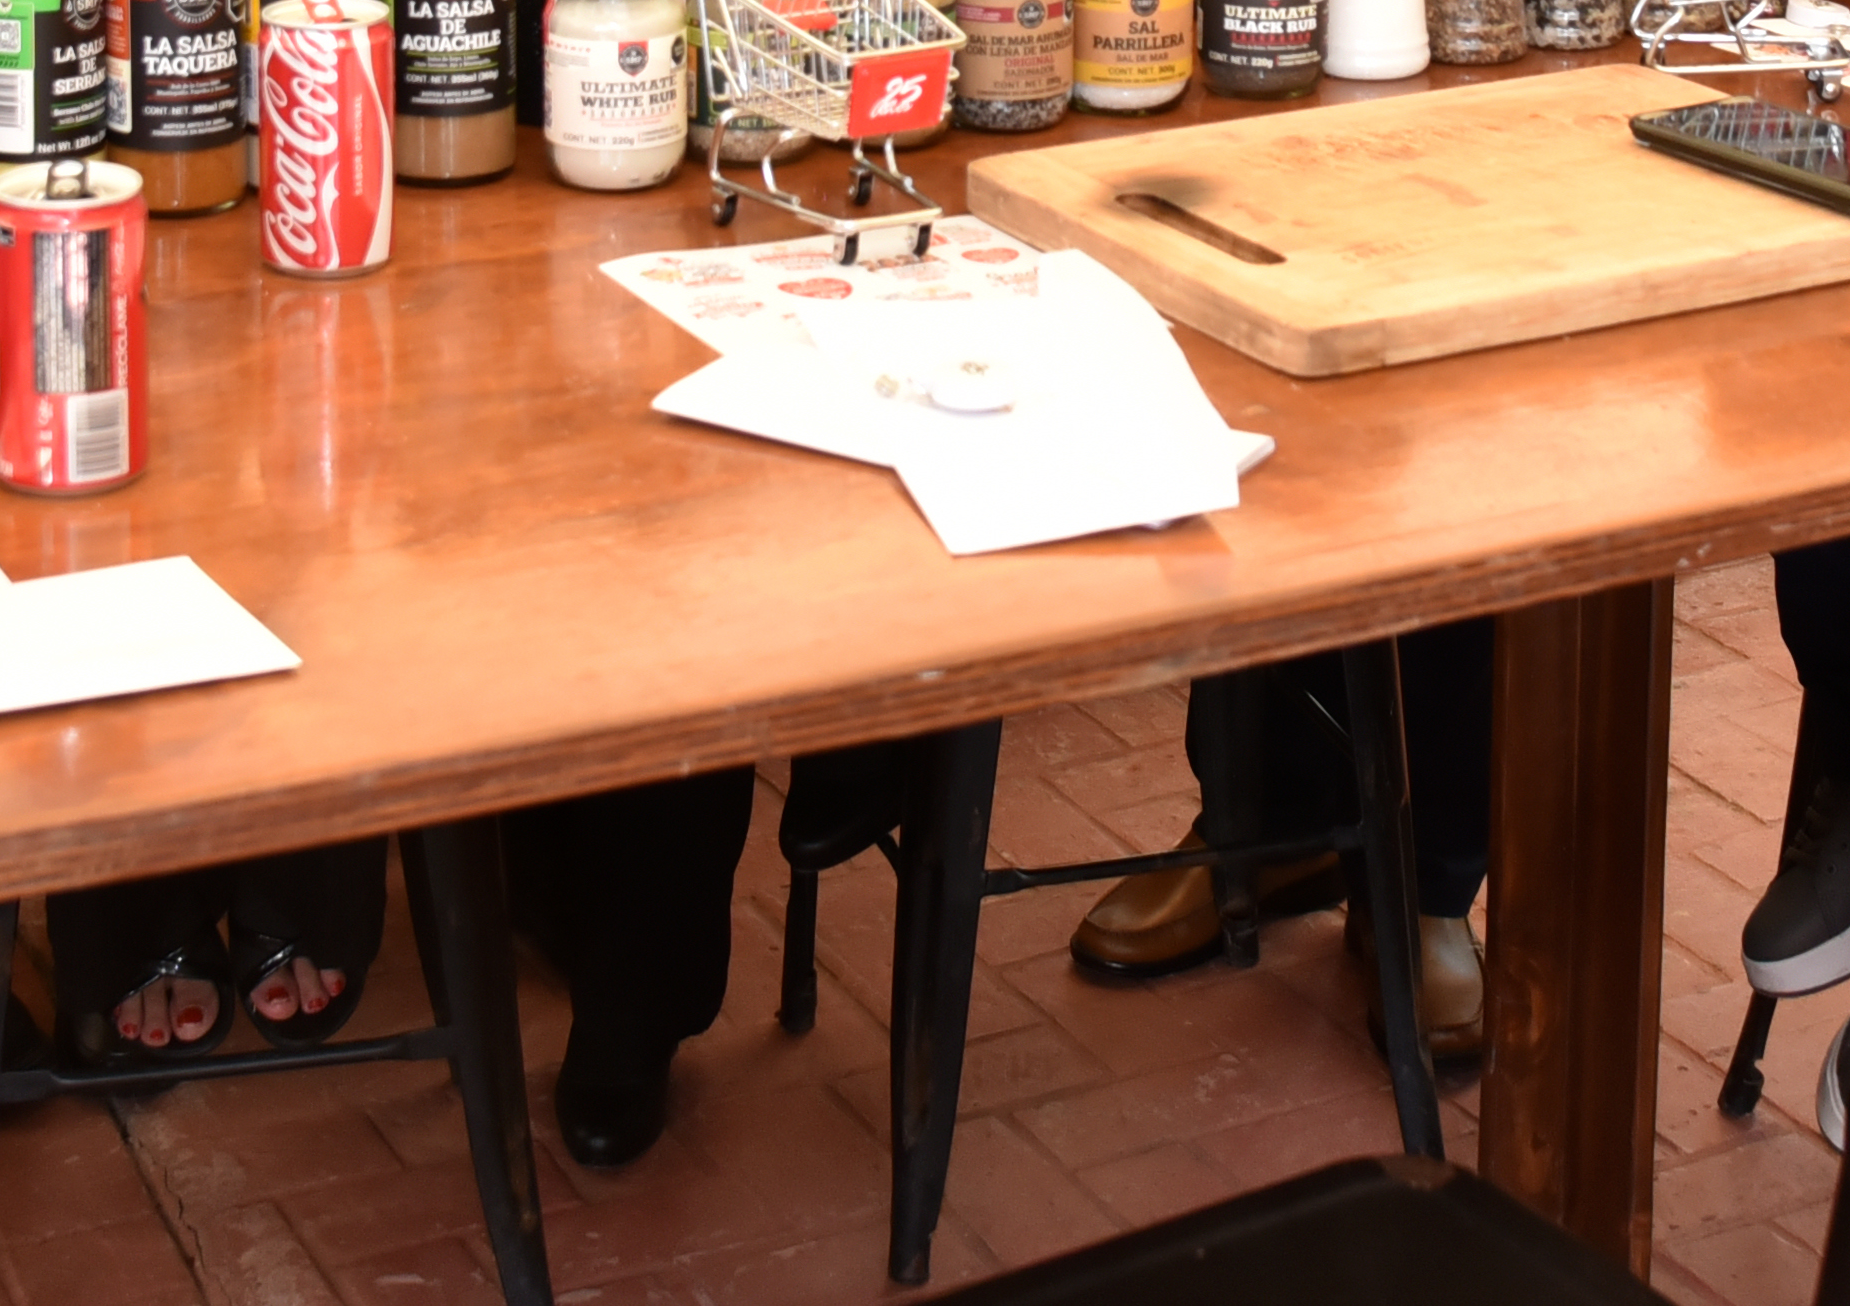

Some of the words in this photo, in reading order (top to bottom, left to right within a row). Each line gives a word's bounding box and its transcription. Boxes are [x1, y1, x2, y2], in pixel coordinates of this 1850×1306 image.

[408, 0, 433, 18] LA
[1224, 4, 1317, 20] ULTIMATE
[440, 19, 467, 35] DE
[1128, 20, 1160, 34] SAL
[1224, 17, 1284, 33] BLACK
[1287, 17, 1317, 32] RUB
[143, 36, 174, 54] LA
[178, 29, 237, 55] SALSA
[402, 29, 501, 51] AGUACHILE
[969, 34, 989, 45] SAL
[992, 36, 1006, 45] DE
[1008, 35, 1035, 45] MAR
[1093, 32, 1185, 50] PARRILLERA
[55, 45, 76, 63] LA
[966, 46, 987, 55] CON
[1023, 47, 1038, 55] DE
[1117, 54, 1133, 62] SAL
[1136, 54, 1147, 62] DE
[1149, 52, 1169, 61] MAR
[81, 56, 98, 74] DE
[142, 48, 238, 76] TAQUERA
[1004, 55, 1053, 68] ORIGINAL
[580, 74, 678, 94] ULTIMATE
[580, 95, 644, 108] WHITE
[648, 89, 678, 105] RUB
[355, 93, 363, 151] ORIGINAL
[37, 140, 56, 153] Net
[264, 25, 339, 270] Coca-Cola
[612, 136, 635, 146] 220g
[355, 154, 363, 196] SABOR
